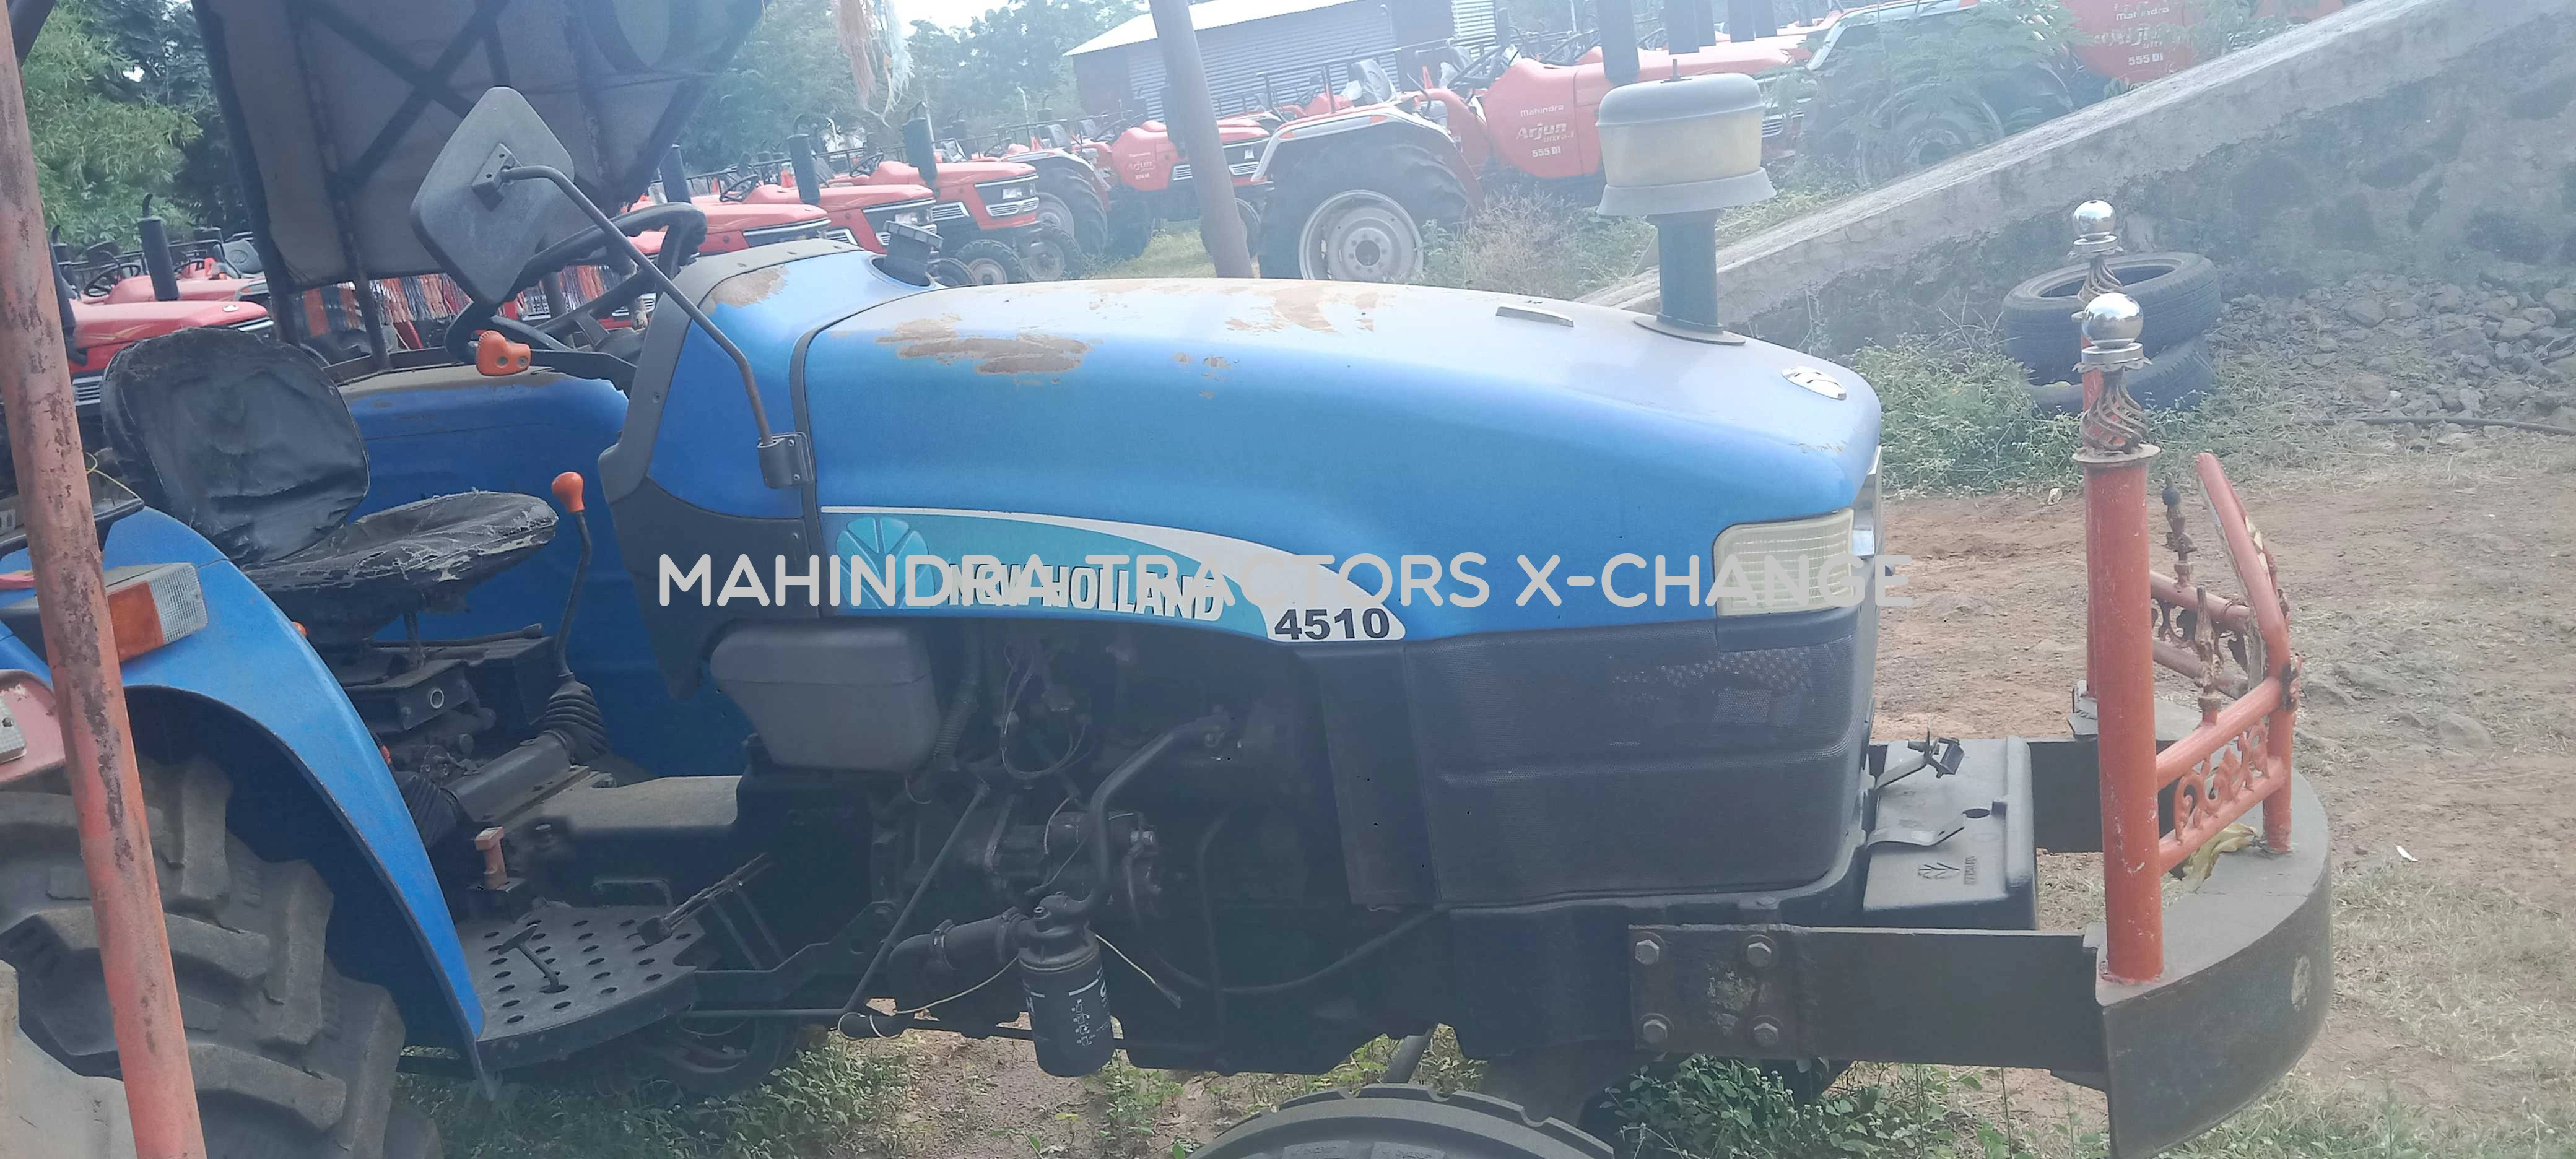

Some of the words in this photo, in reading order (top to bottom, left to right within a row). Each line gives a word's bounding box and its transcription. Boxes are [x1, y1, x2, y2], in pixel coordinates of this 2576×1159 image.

[2128, 54, 2150, 66] 555
[1515, 123, 1567, 140] Arjun
[1532, 147, 1550, 158] 555
[1041, 565, 1224, 622] HOLLAND
[1274, 608, 1390, 640] 4510
